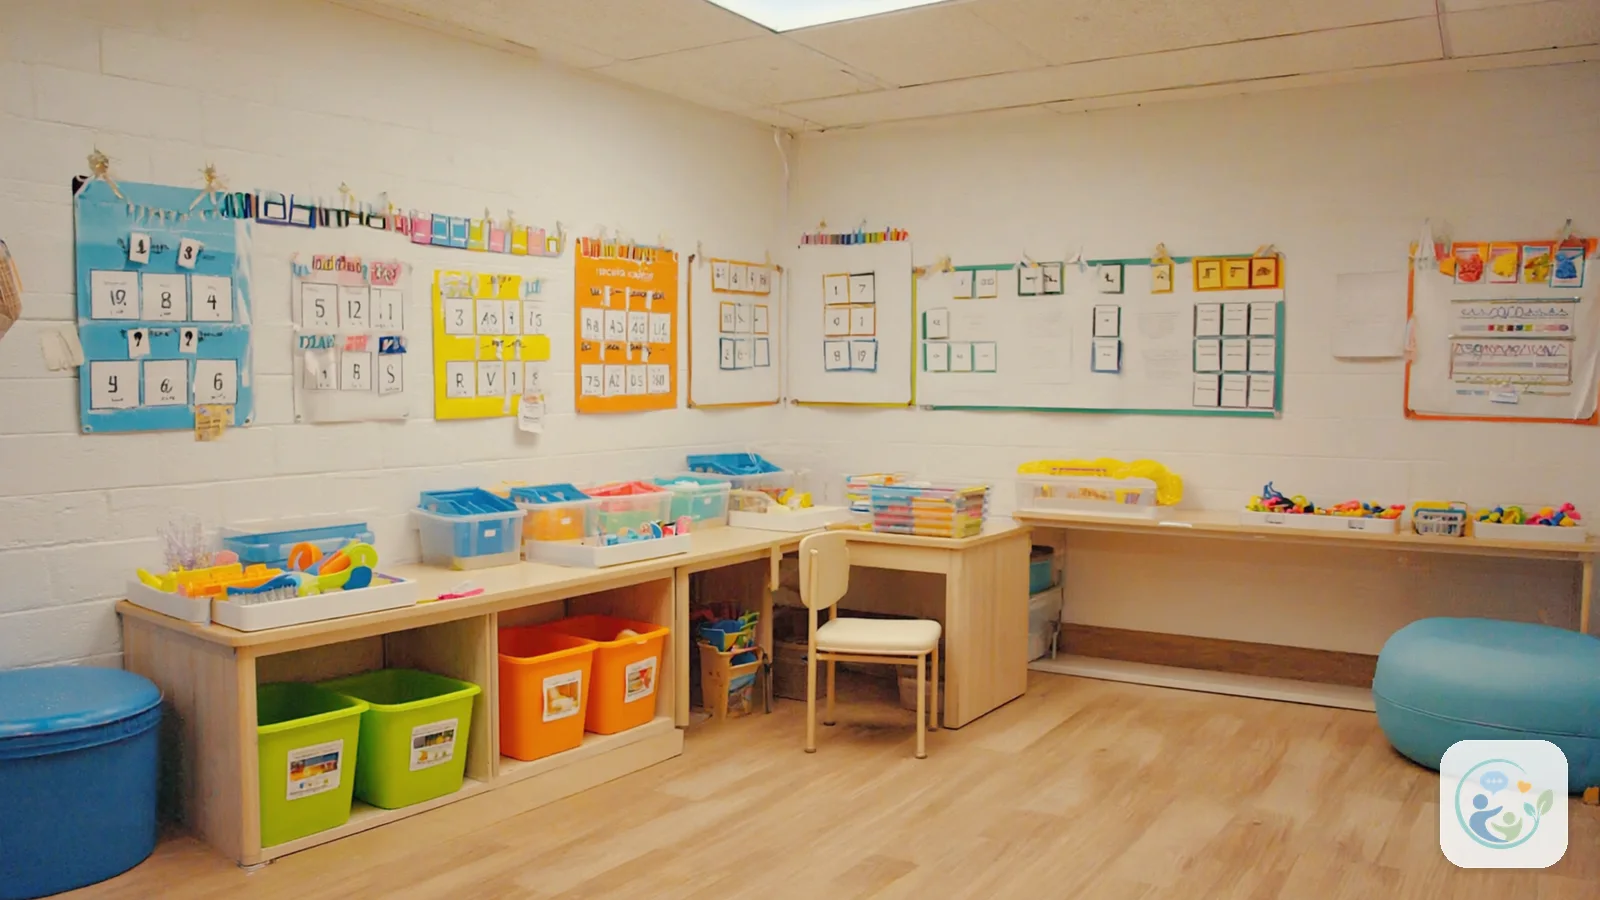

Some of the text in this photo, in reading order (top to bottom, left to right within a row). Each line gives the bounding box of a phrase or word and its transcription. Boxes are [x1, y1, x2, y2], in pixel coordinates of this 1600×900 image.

[161, 291, 172, 309] 8
[207, 294, 217, 310] 4
[315, 298, 325, 318] 5
[347, 300, 362, 319] 12
[455, 309, 464, 326] 3
[213, 373, 223, 391] 6
[486, 372, 496, 386] V
